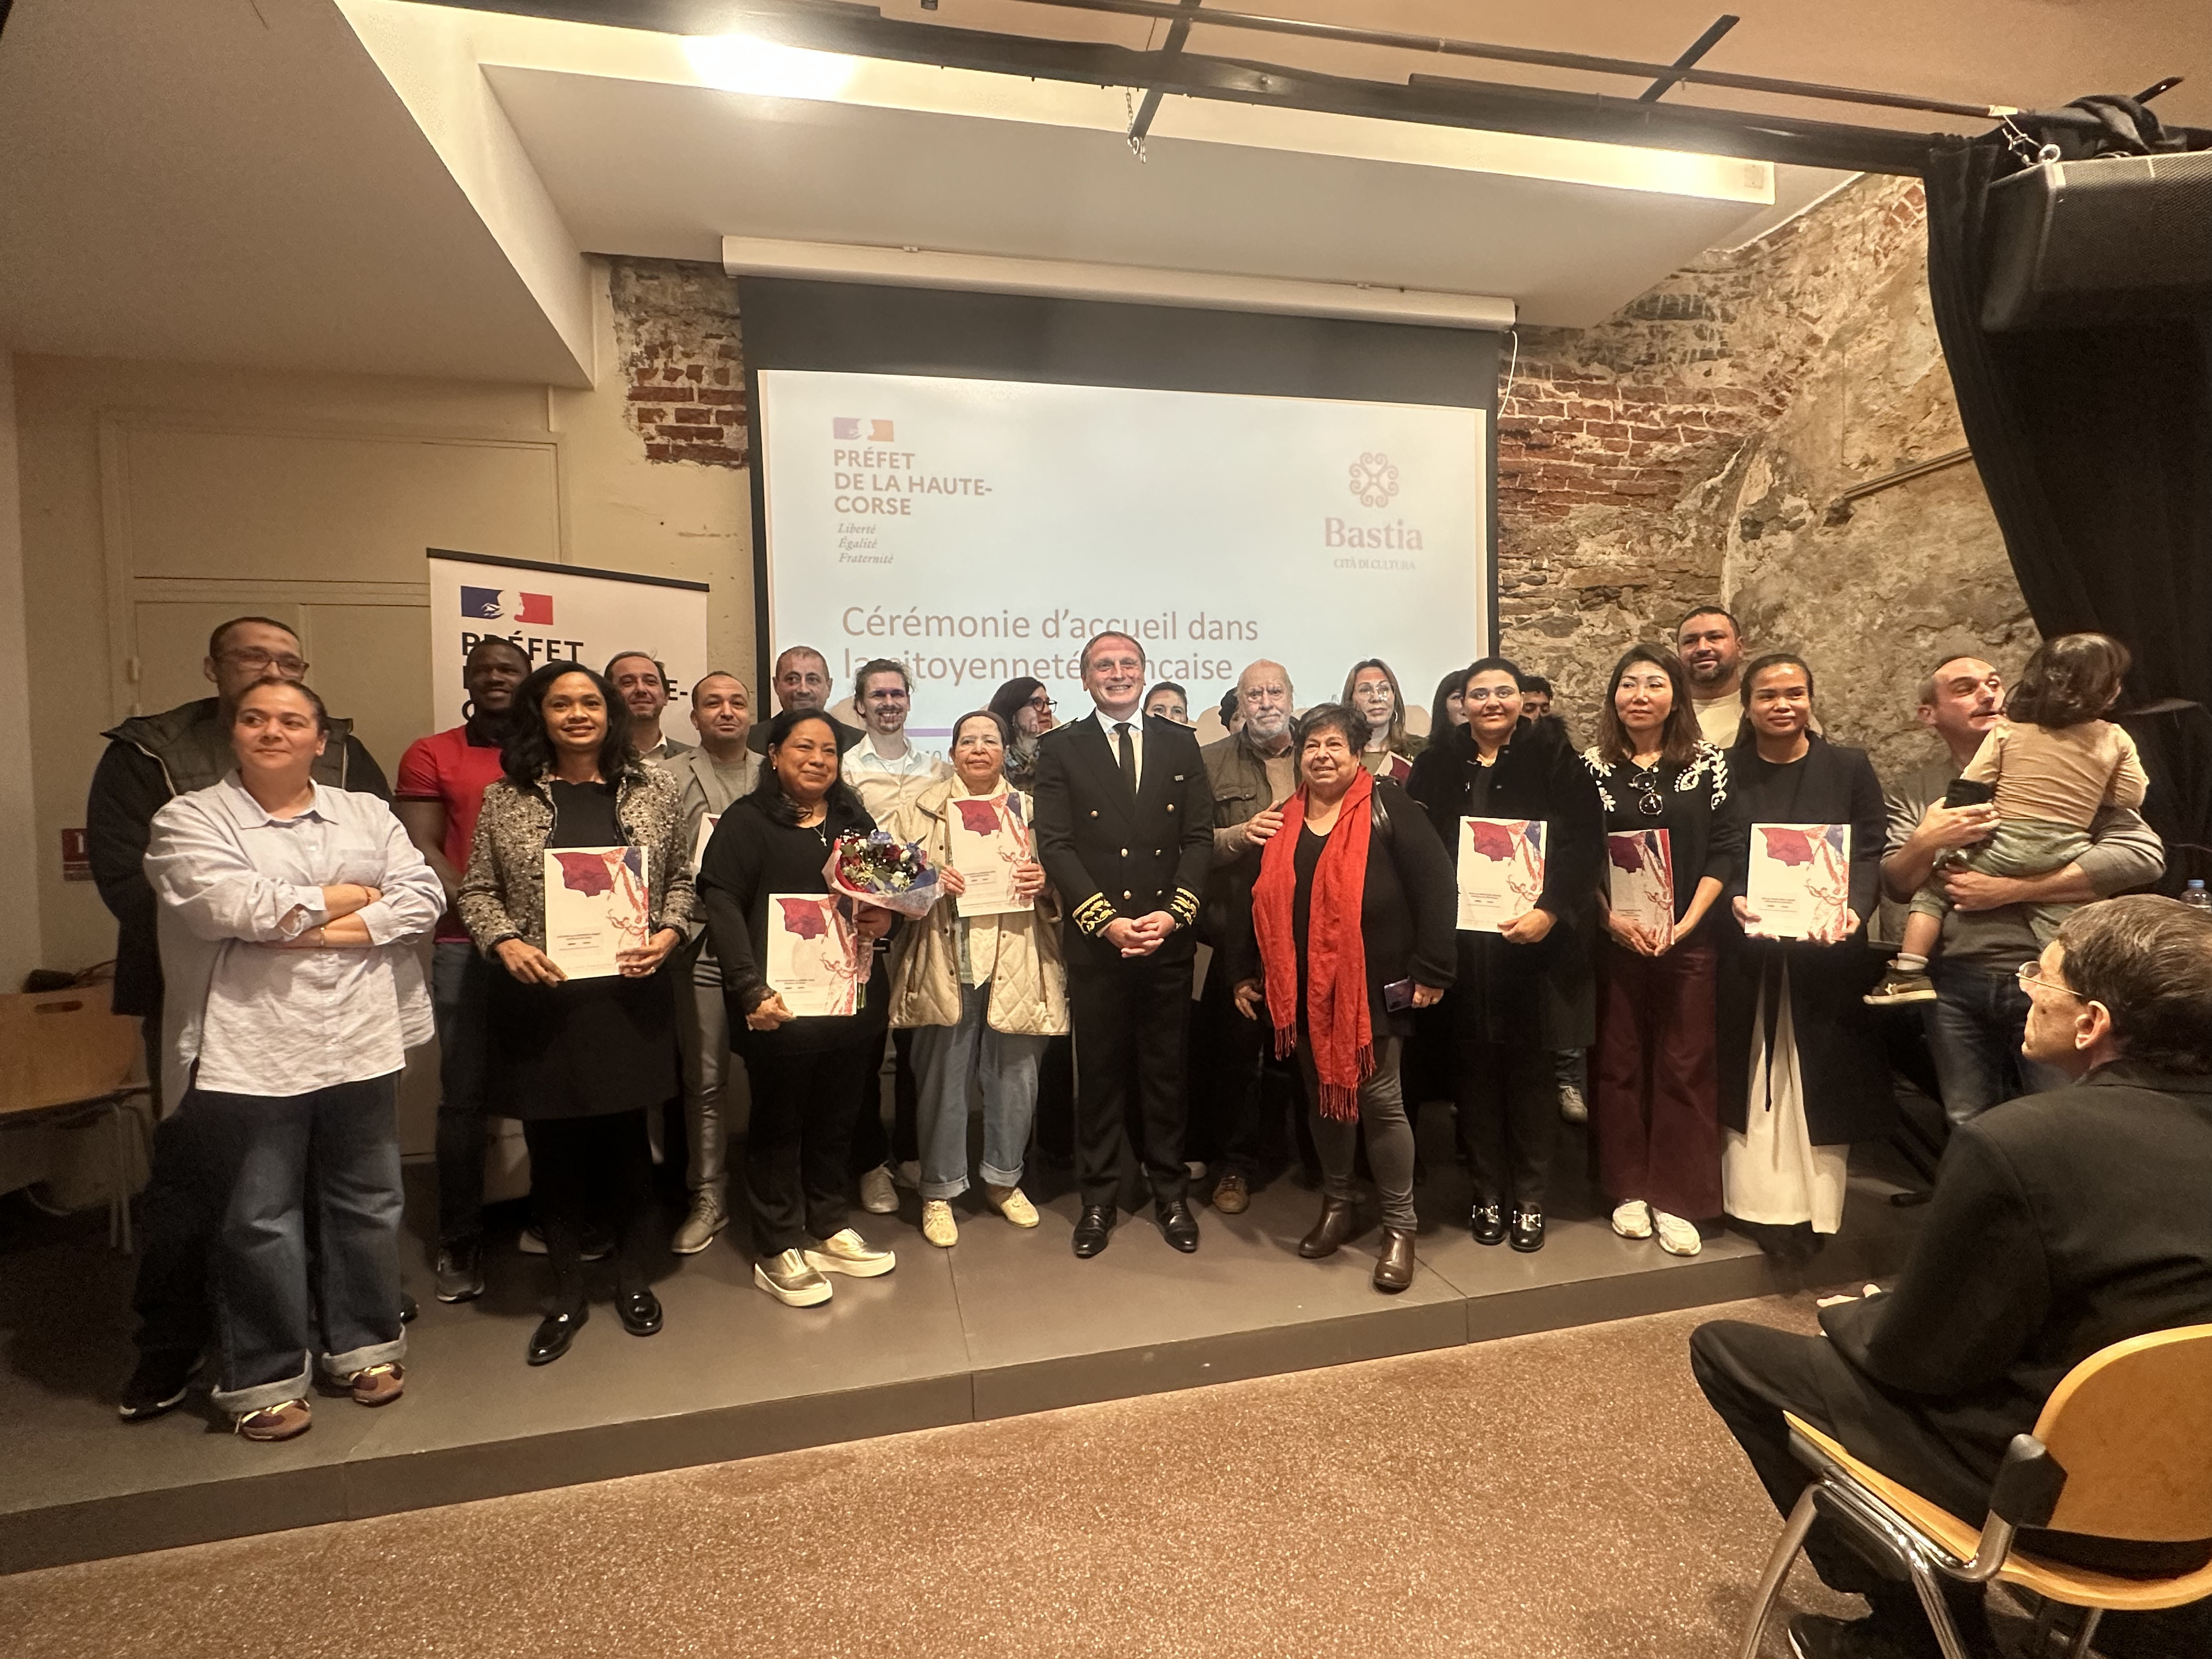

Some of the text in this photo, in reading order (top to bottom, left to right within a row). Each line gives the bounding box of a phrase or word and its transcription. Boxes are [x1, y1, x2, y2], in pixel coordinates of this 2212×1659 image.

[834, 447, 915, 469] PRÉFET
[834, 472, 992, 495] DE LA HAUTE-
[834, 495, 911, 515] CORSE
[837, 523, 876, 534] Liberté
[1324, 517, 1423, 550] Bastia
[838, 536, 877, 550] Égalité
[838, 552, 894, 564] Fraternité
[843, 606, 1030, 637] Cérémonie
[1188, 612, 1258, 640] dans
[890, 650, 1080, 686] itoyenneté
